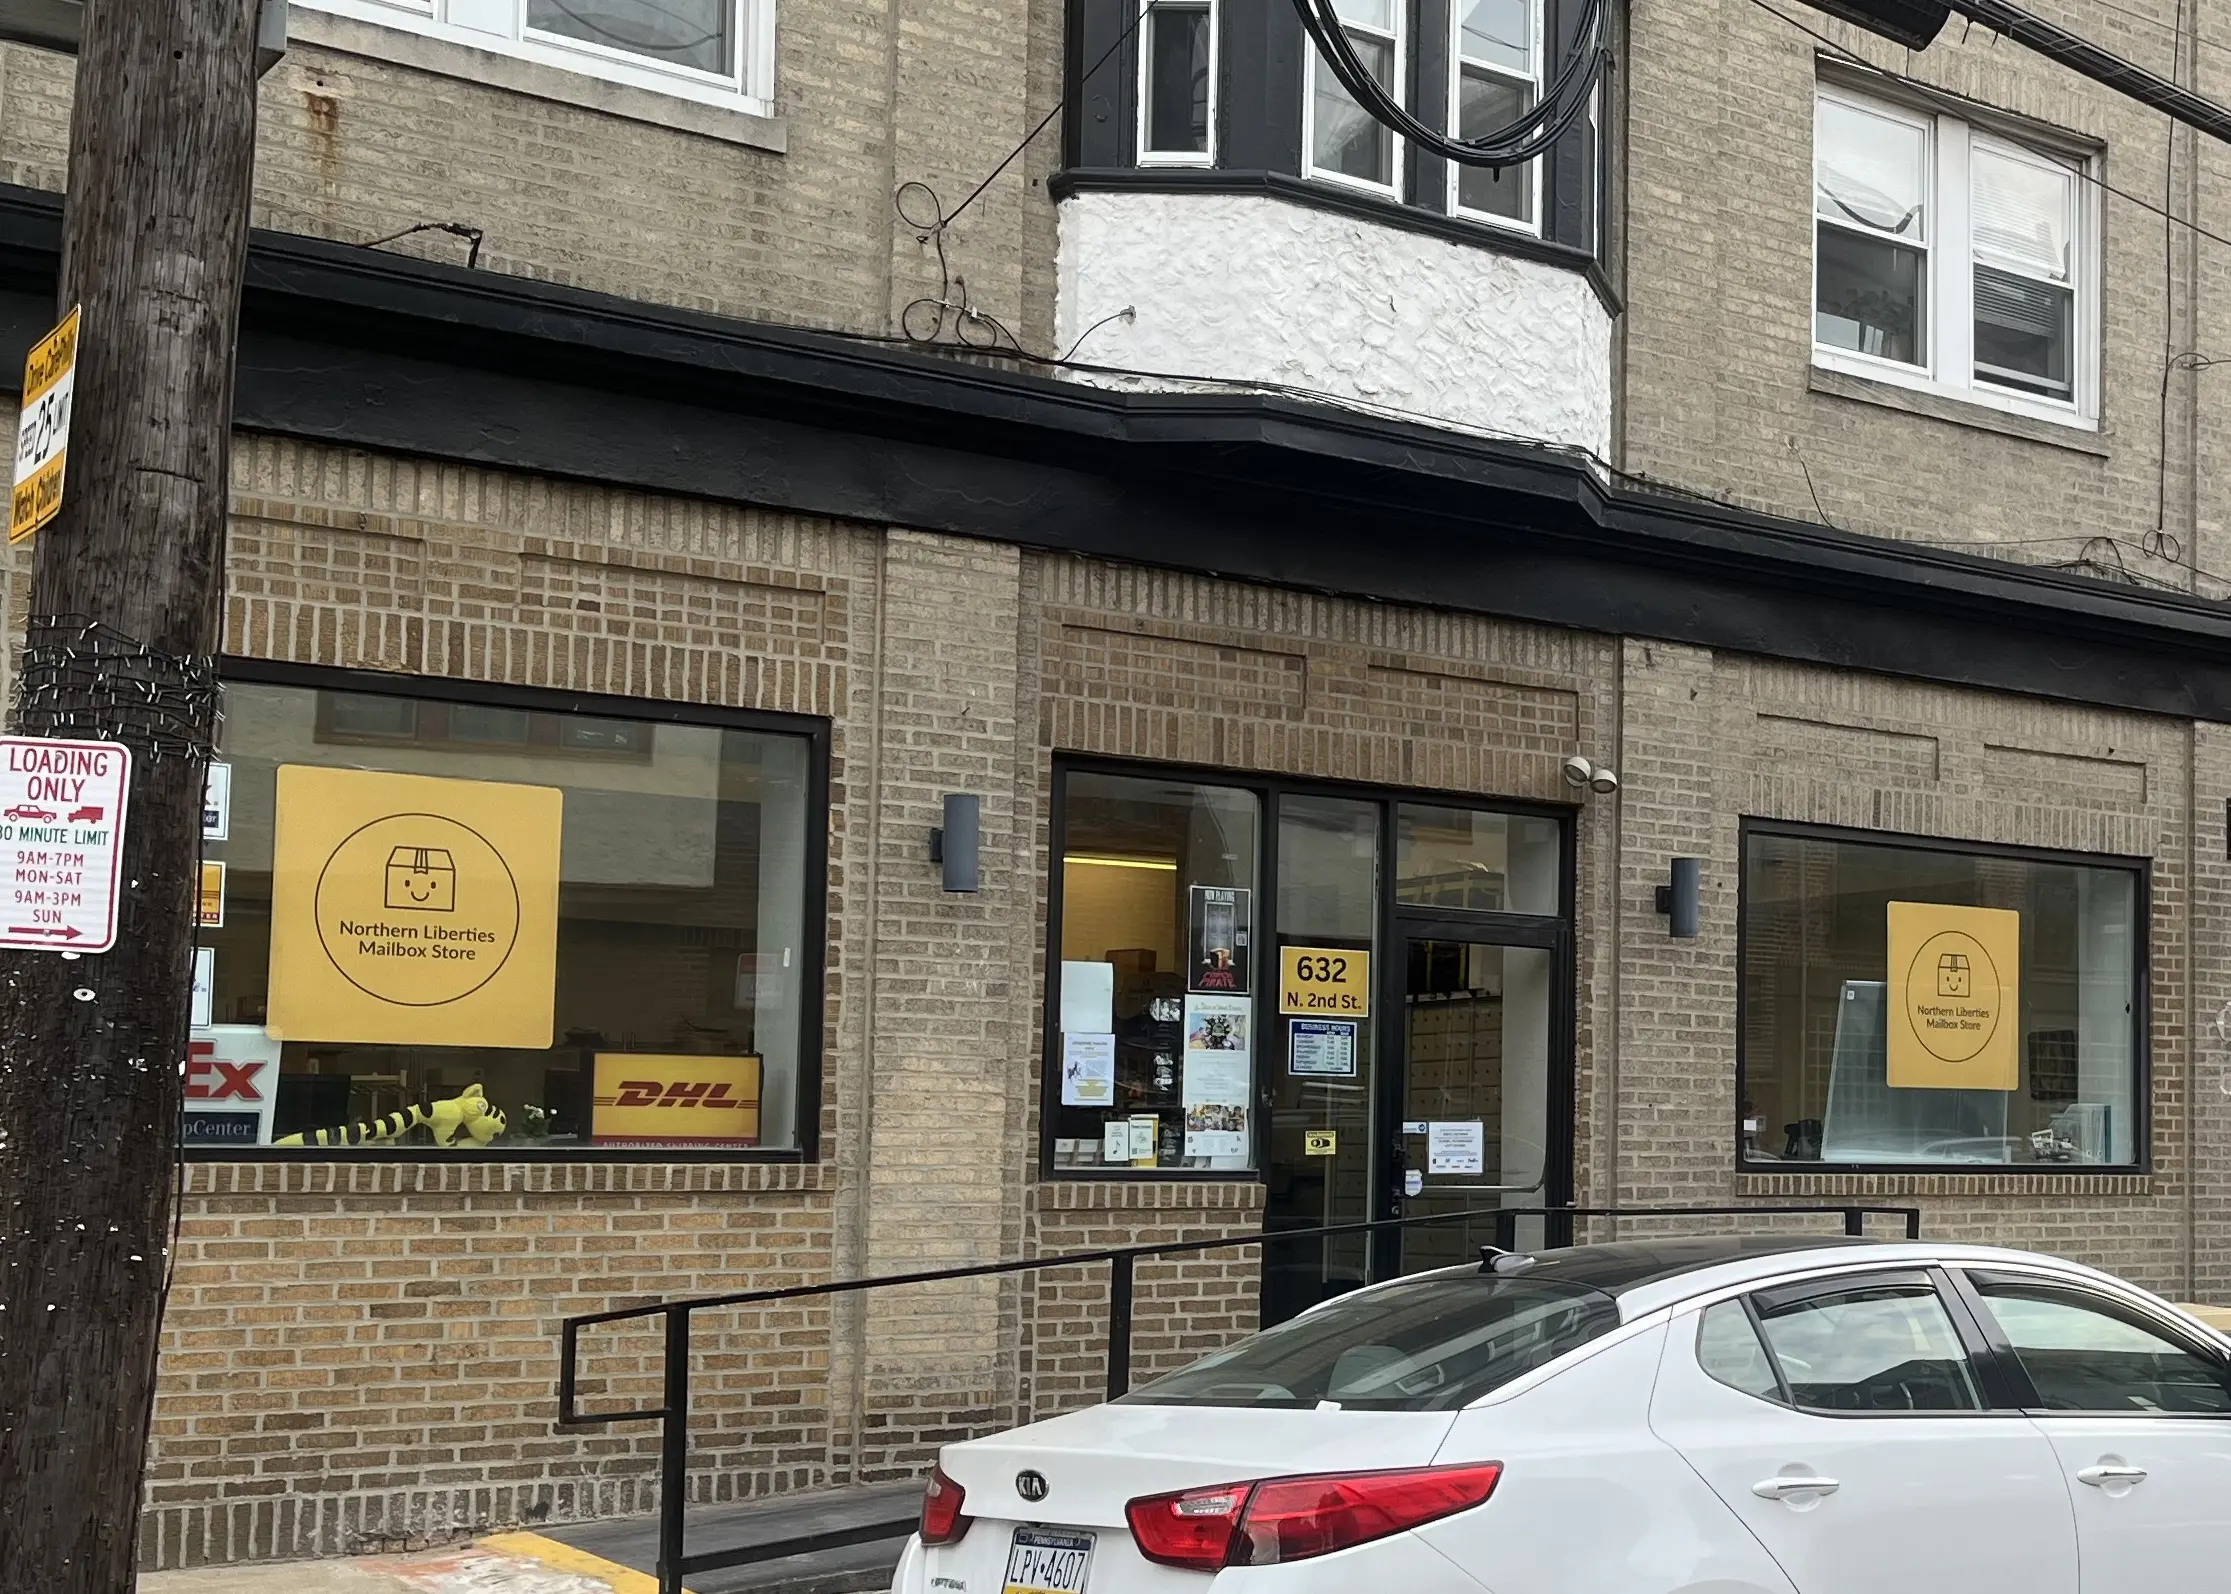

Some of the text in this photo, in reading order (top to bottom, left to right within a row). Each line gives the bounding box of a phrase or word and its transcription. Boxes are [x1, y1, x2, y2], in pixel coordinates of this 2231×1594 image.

[34, 392, 55, 465] 25
[9, 748, 109, 777] LOADING
[28, 776, 86, 803] ONLY
[19, 827, 68, 844] MINUTE
[75, 829, 109, 846] LIMIT
[17, 850, 84, 867] 9AM-7PM
[16, 869, 83, 885] MON-SAT
[14, 890, 82, 906] 9AM-3PM
[1216, 890, 1235, 903] PLAYING
[33, 909, 62, 924] SUN
[339, 920, 496, 942] Northern Liberties
[358, 940, 476, 960] Mailbox Store
[1297, 955, 1348, 984] 632
[1287, 992, 1362, 1010] N. 2nd St.
[1917, 1004, 1990, 1018] Northern Liberties
[1926, 1018, 1981, 1030] Mailbox Store
[615, 1080, 738, 1109] DHL
[603, 1141, 663, 1149] AUTHORIZED
[1018, 1476, 1043, 1496] KIA
